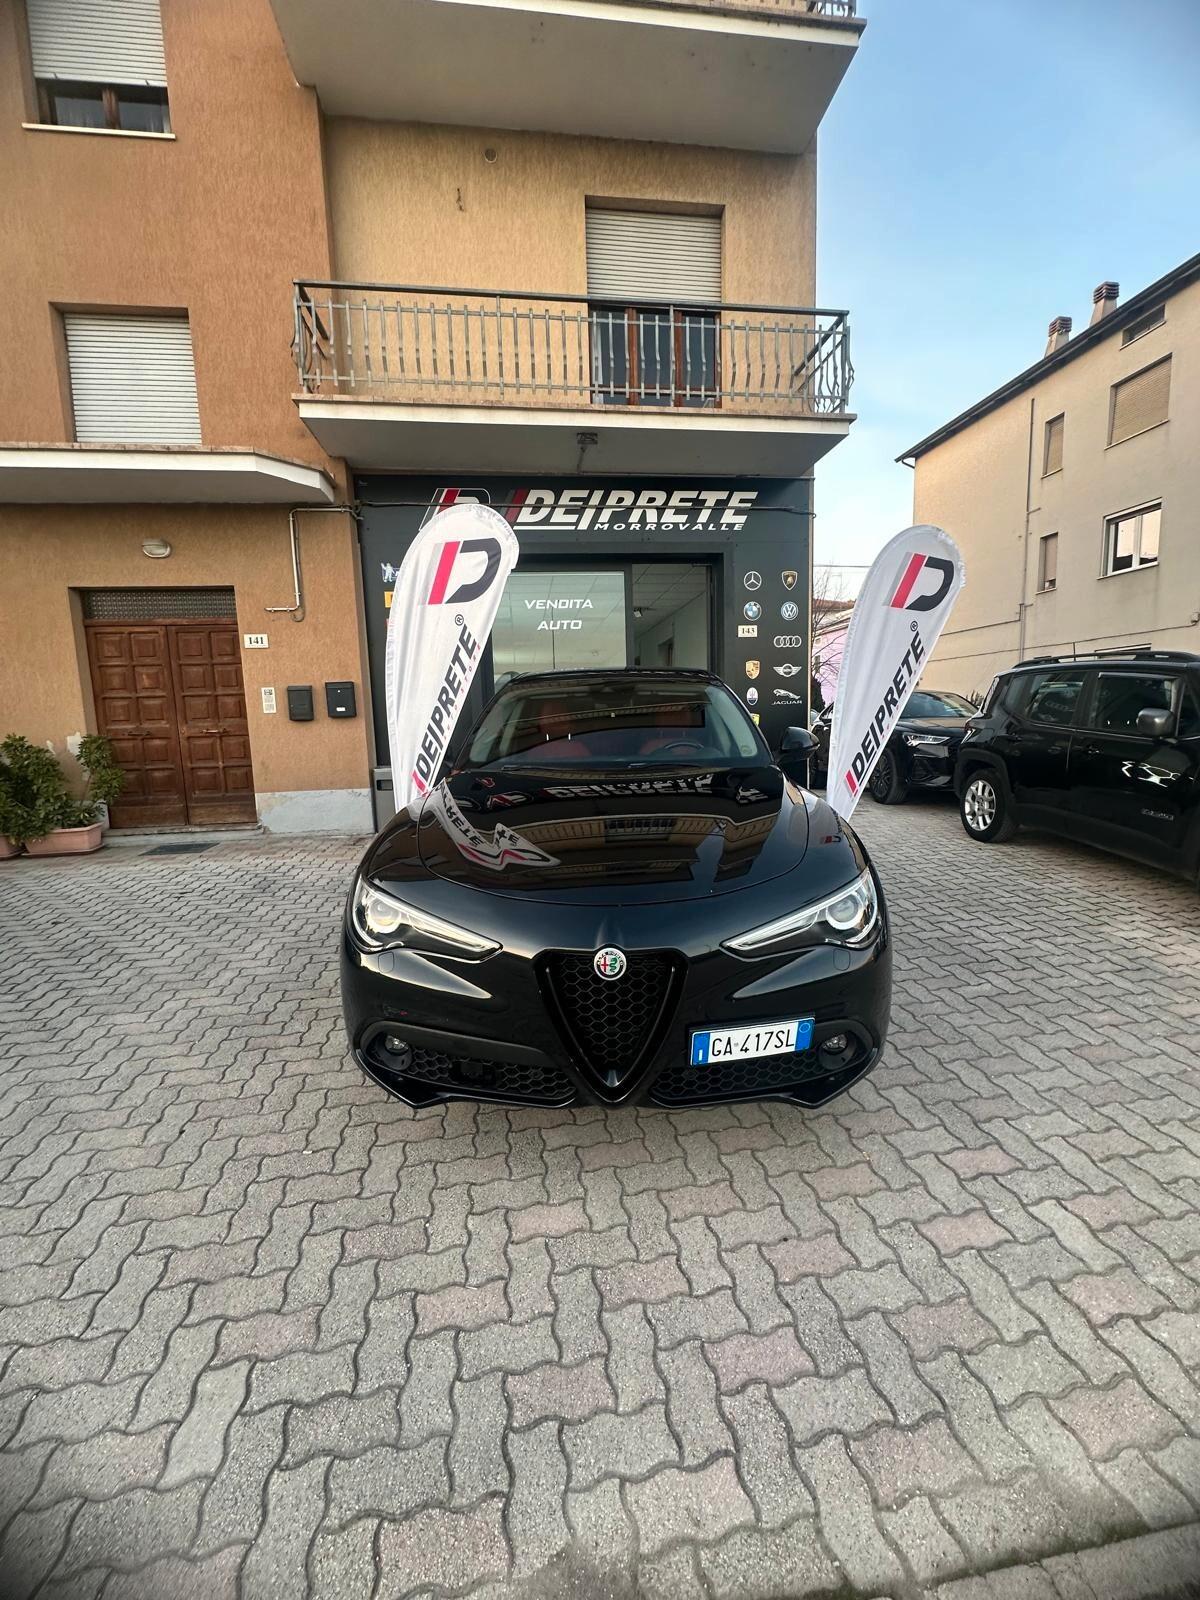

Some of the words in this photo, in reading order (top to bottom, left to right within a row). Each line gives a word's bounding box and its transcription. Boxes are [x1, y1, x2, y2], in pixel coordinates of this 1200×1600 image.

[594, 523, 745, 531] MORROVALLE
[524, 599, 594, 610] VENDITA
[537, 620, 583, 631] AUTO
[248, 636, 264, 644] 141
[711, 1037, 733, 1057] GA
[740, 1029, 795, 1053] 417SL
